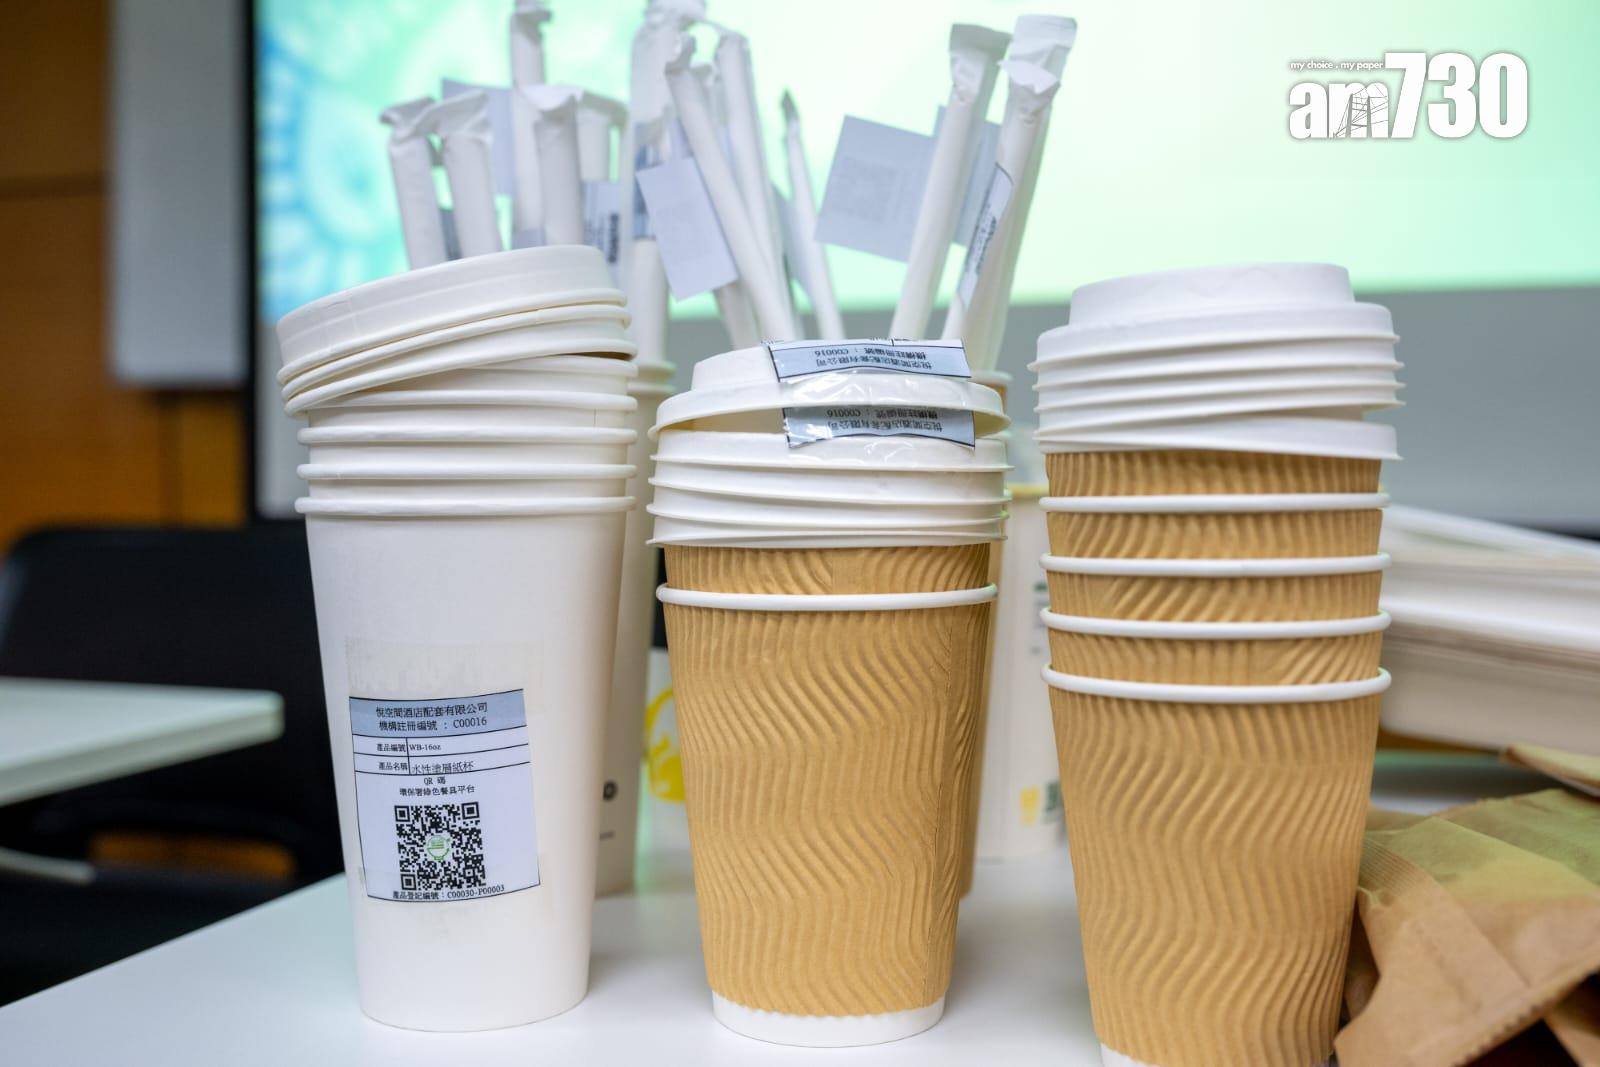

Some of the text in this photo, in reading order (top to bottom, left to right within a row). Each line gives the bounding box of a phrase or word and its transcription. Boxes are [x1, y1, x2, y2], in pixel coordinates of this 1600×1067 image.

[453, 716, 488, 729] C00016
[409, 743, 442, 751] WB-16oz
[423, 777, 433, 786] QR
